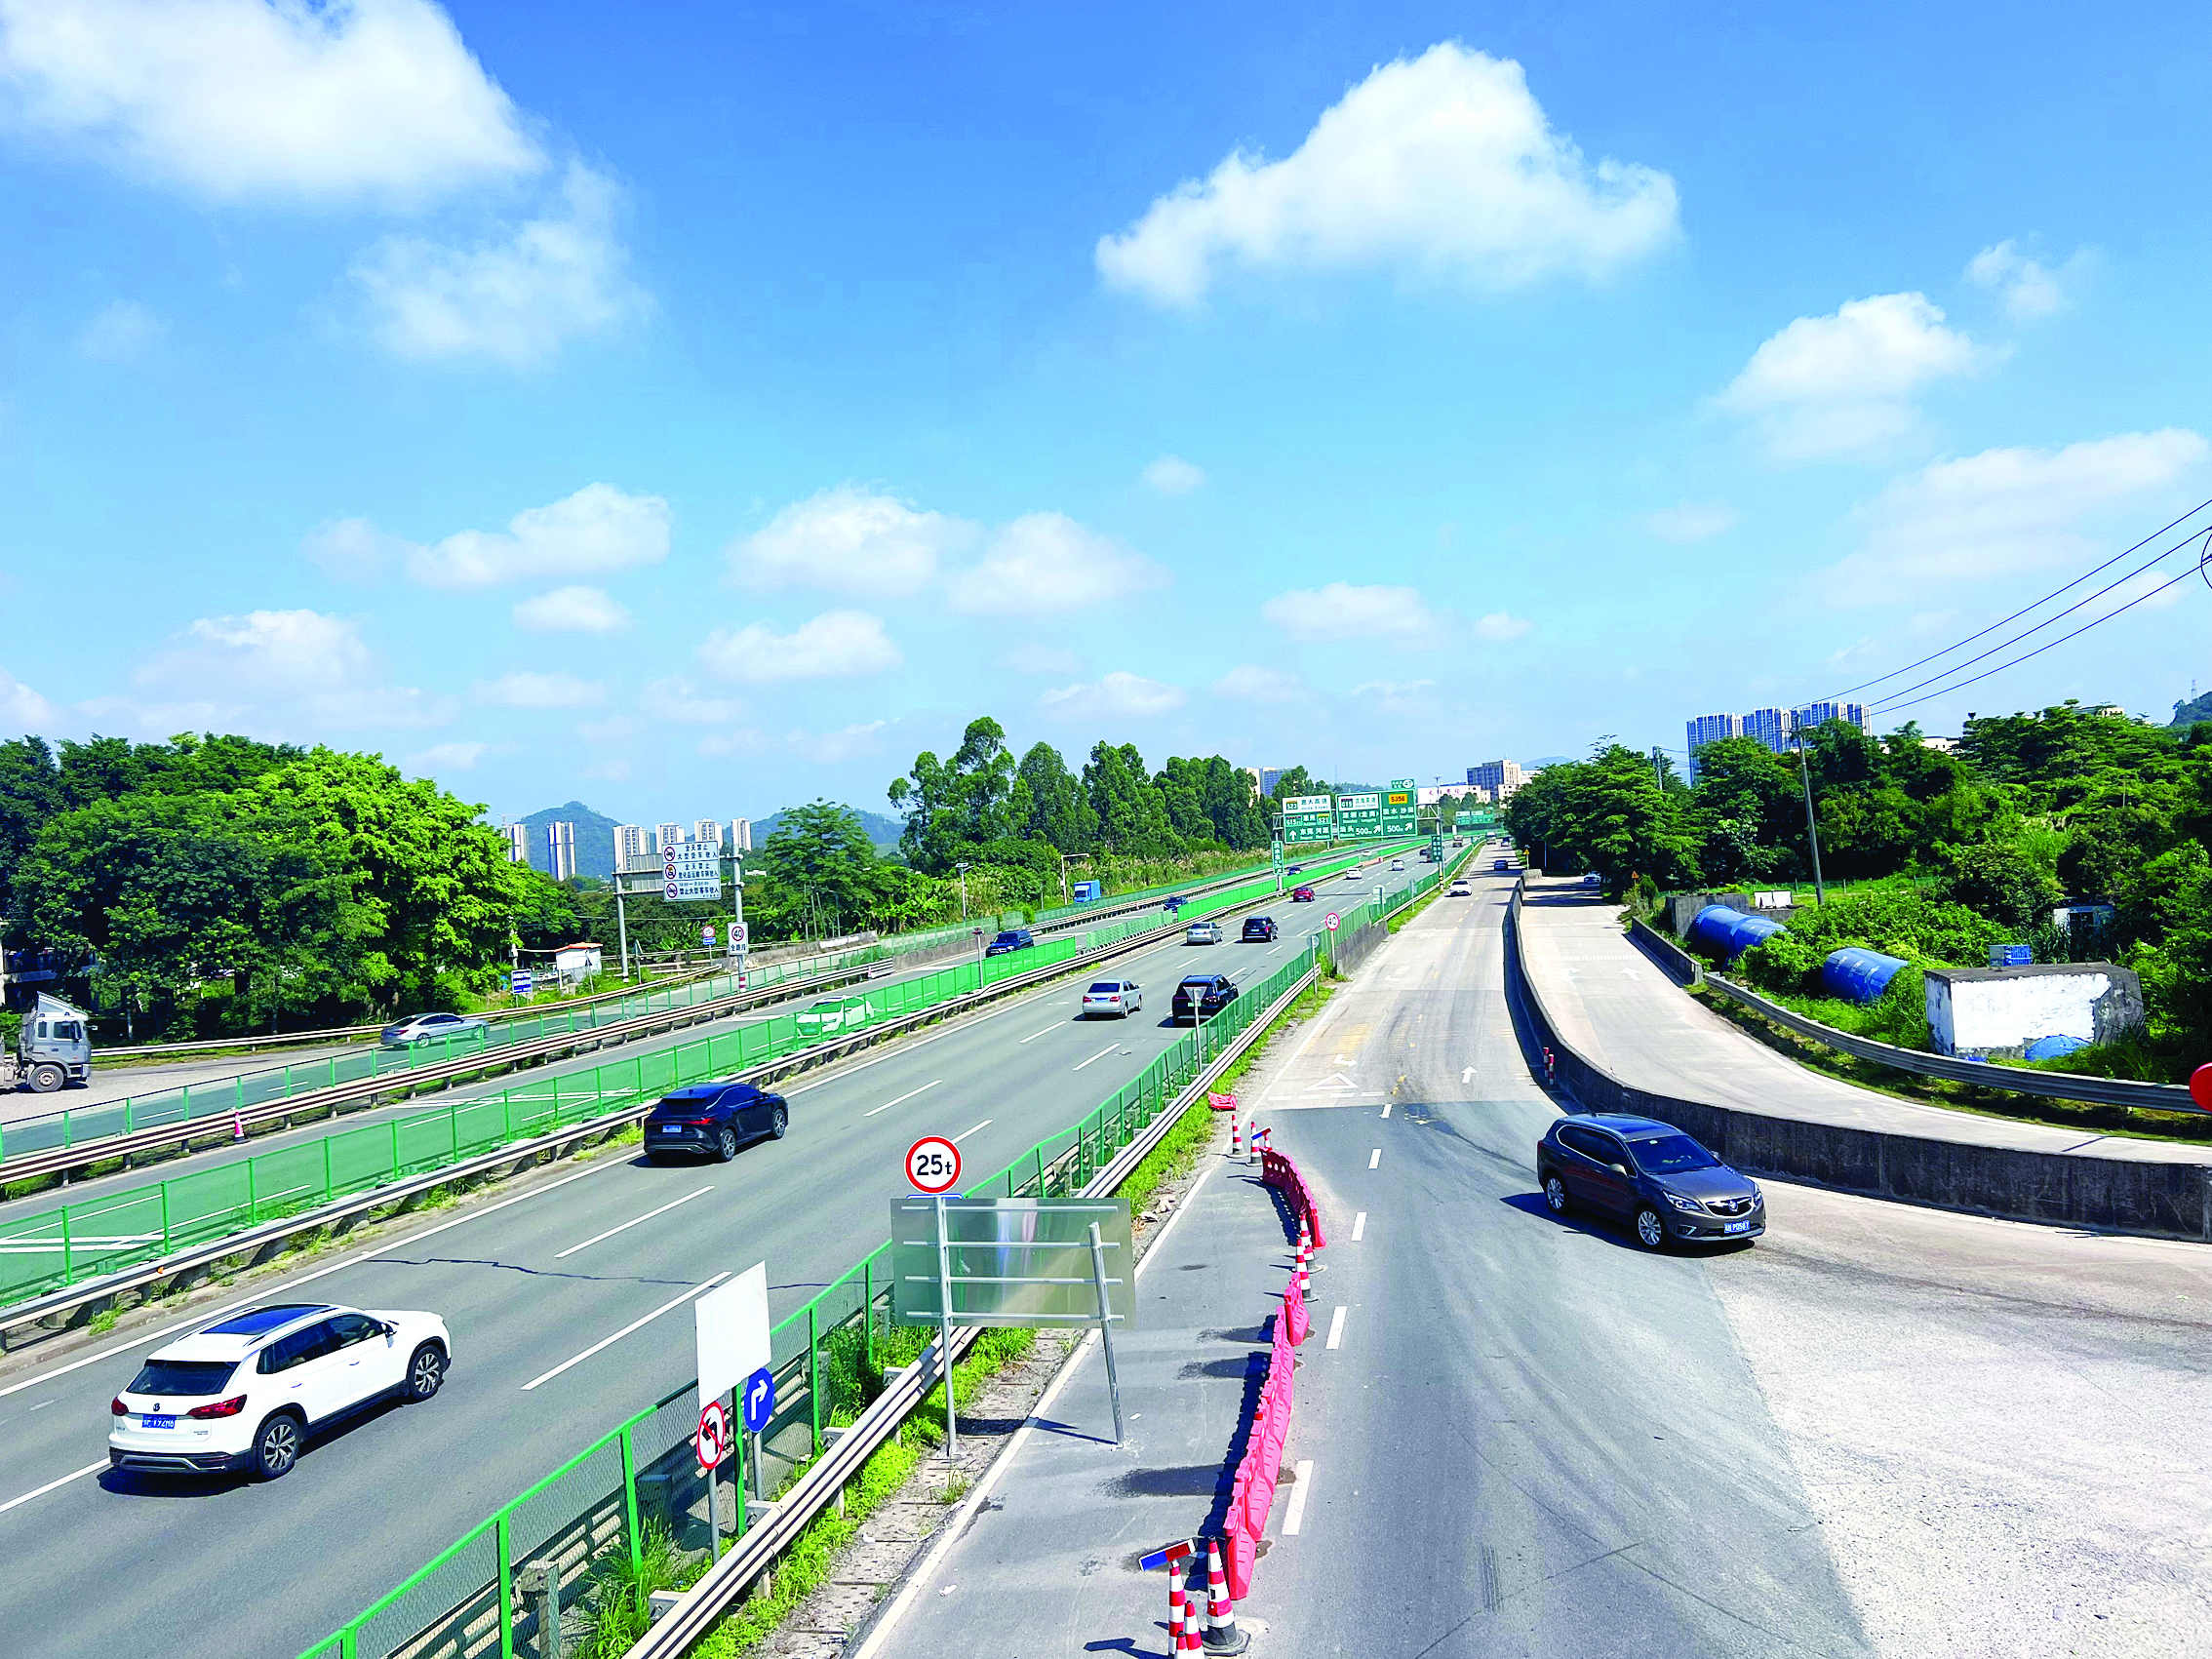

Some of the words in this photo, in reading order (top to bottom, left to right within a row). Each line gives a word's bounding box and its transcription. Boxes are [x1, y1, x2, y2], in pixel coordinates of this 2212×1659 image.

[1327, 917, 1336, 926] 40
[733, 929, 742, 938] 40
[917, 1155, 952, 1176] 25t
